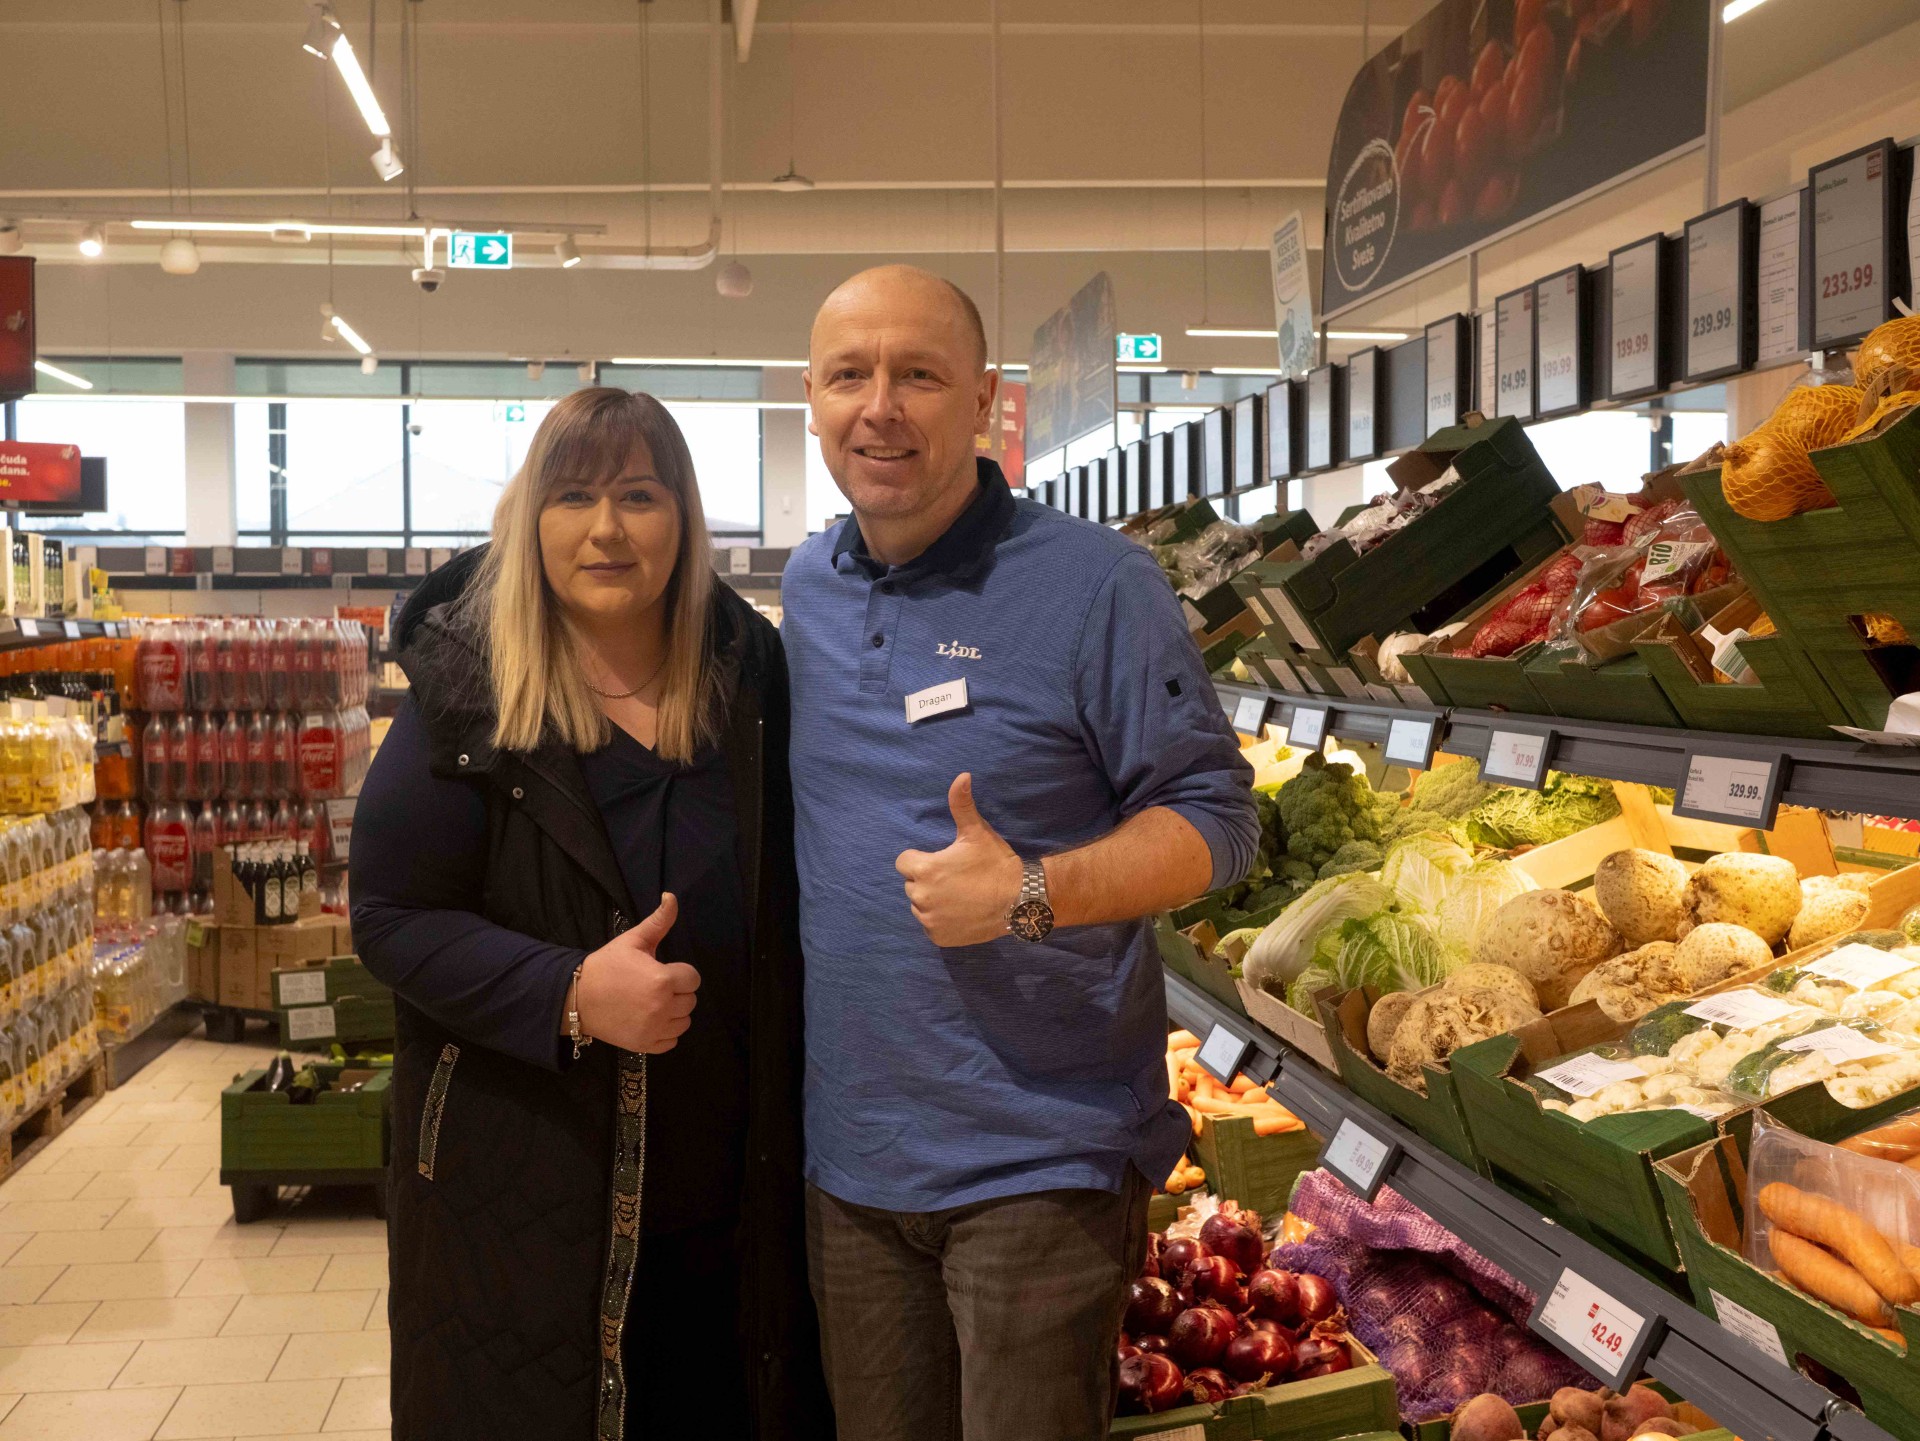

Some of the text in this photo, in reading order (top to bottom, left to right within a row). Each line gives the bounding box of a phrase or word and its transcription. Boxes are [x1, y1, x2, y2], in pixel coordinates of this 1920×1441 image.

[1344, 211, 1386, 247] Kvalitetno
[1351, 242, 1376, 271] Sveže
[1823, 263, 1873, 298] 233.99
[1692, 307, 1732, 338] 239.99
[1616, 333, 1649, 359] 139.99
[1501, 368, 1527, 394] 64.99
[918, 692, 953, 709] Dragan
[1729, 782, 1758, 800] 329.99
[1355, 1153, 1374, 1173] 49.99
[1591, 1322, 1622, 1352] 42.49
